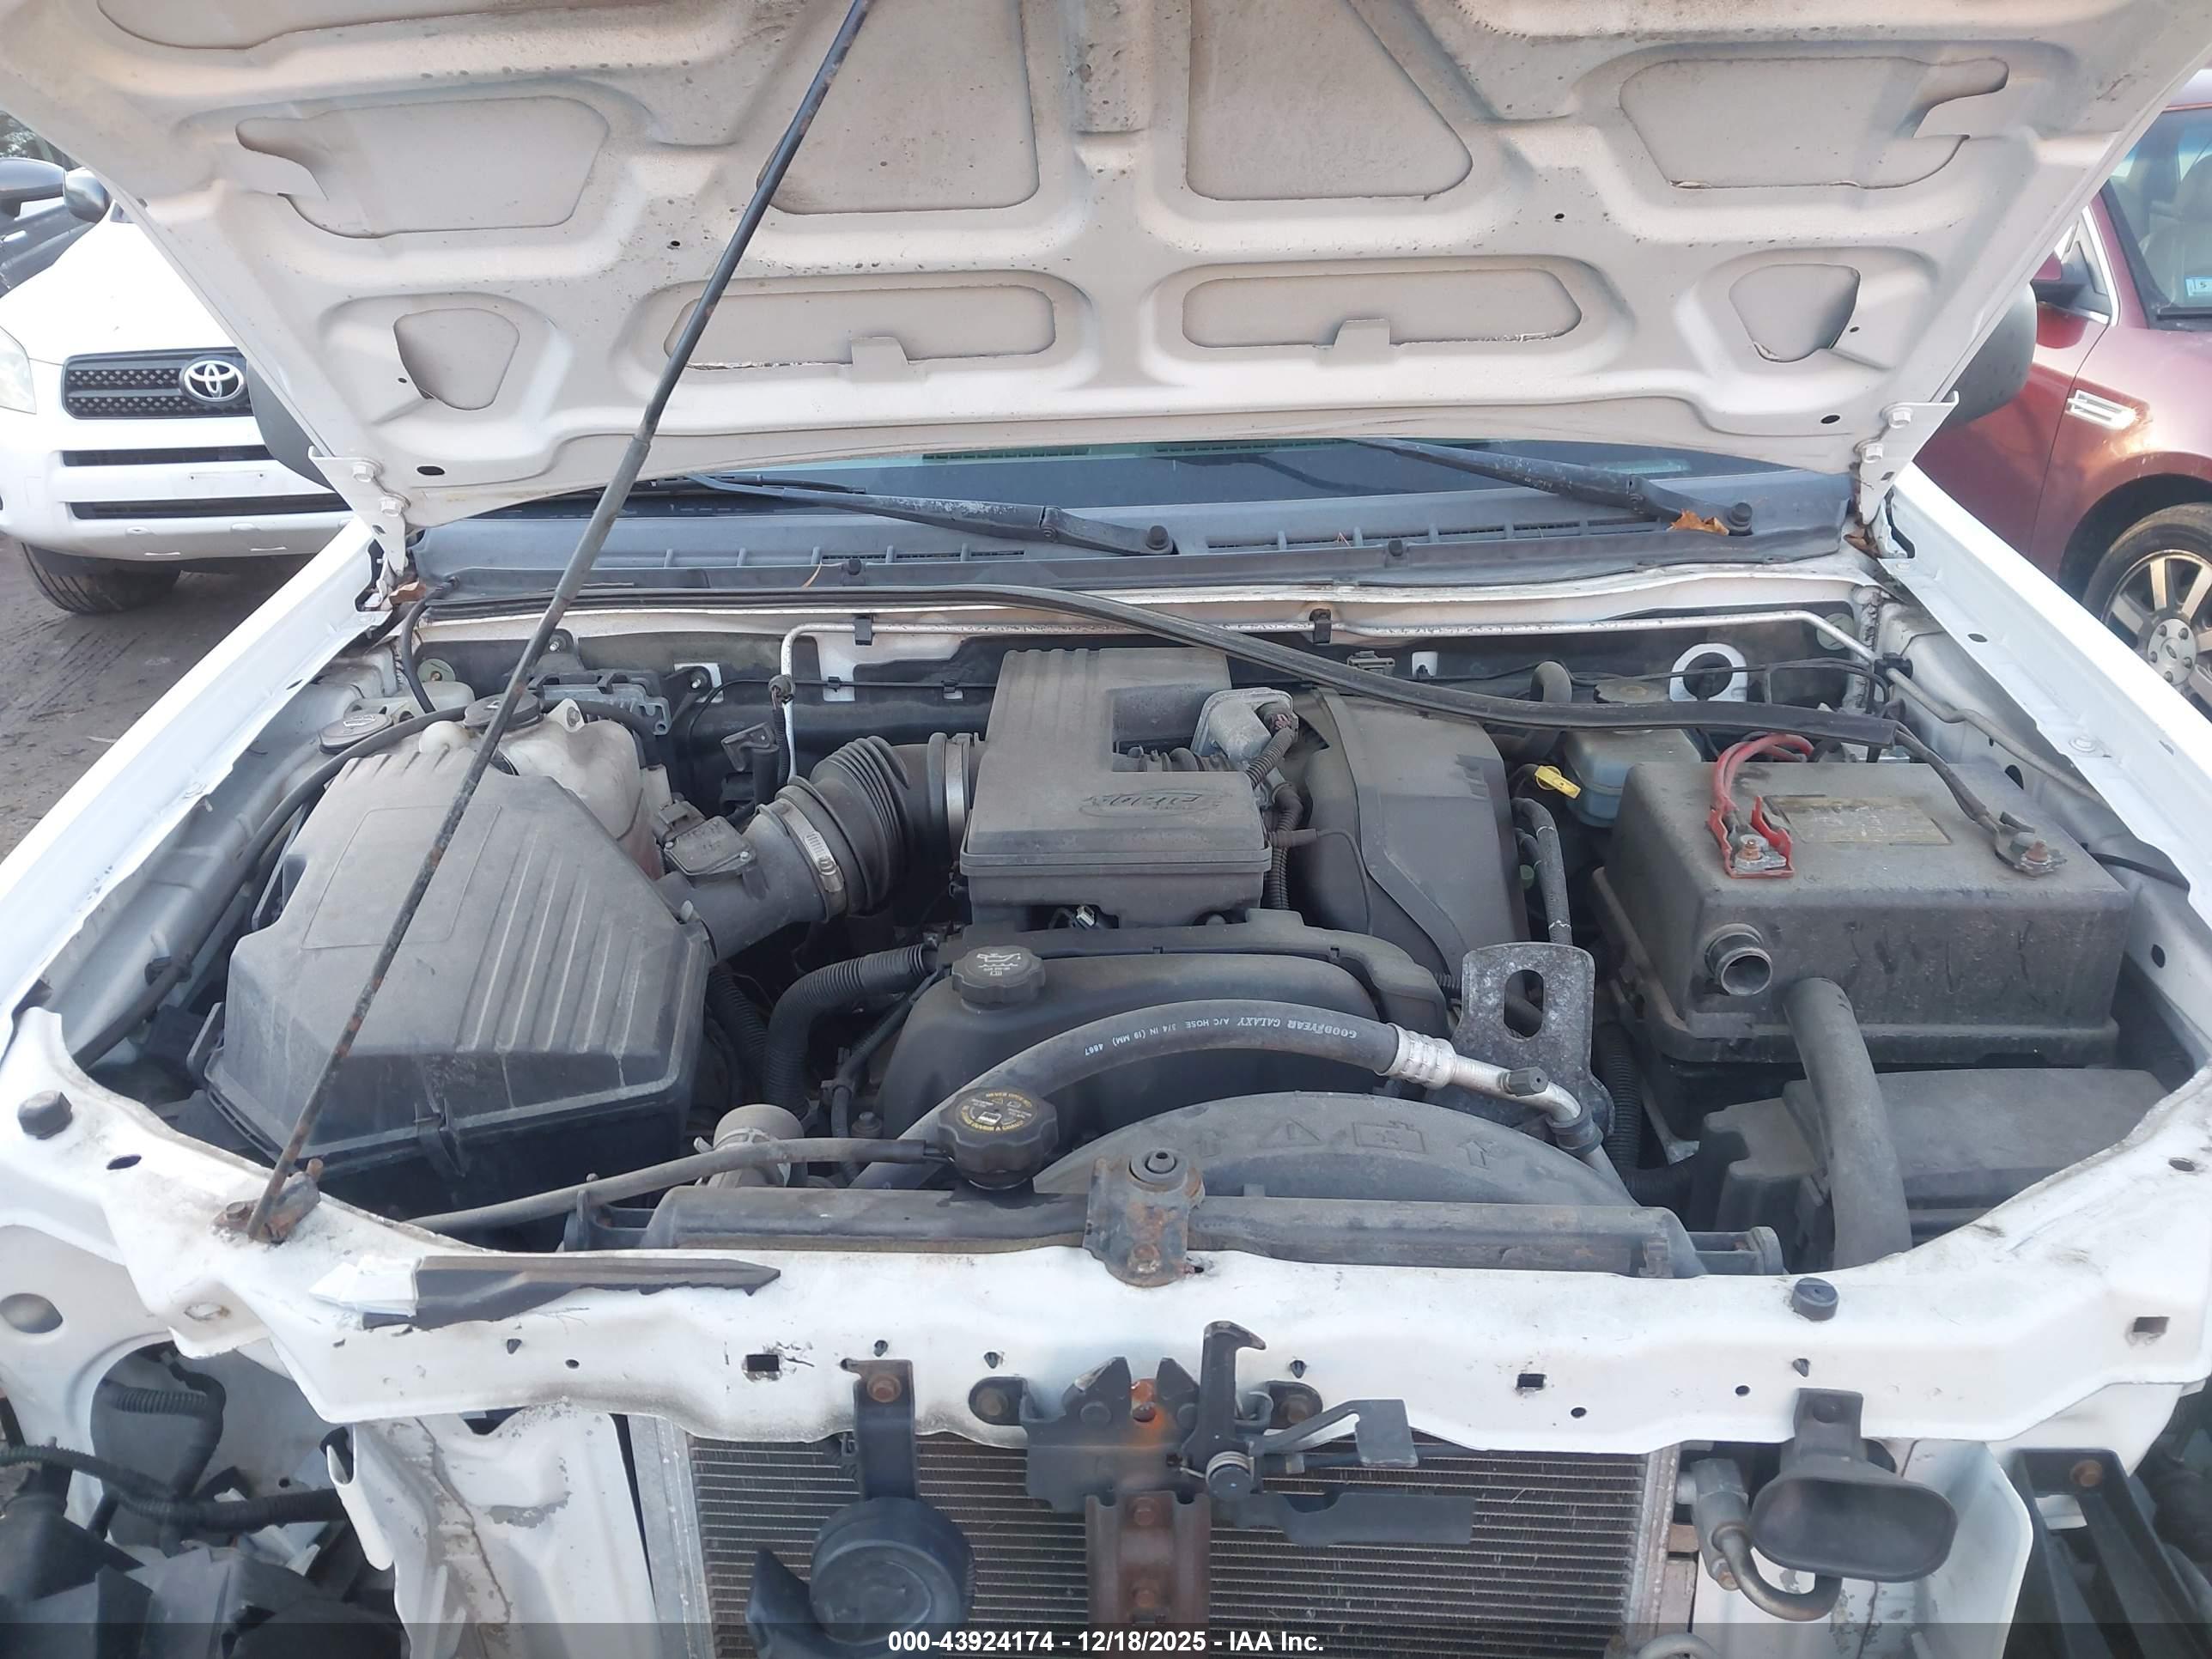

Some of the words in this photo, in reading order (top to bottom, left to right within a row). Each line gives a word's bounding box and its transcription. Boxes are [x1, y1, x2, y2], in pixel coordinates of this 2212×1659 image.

[1185, 1019, 1209, 1029] HOSE
[1237, 1017, 1281, 1027] GALAXY
[1150, 1027, 1159, 1036] IN
[1163, 1024, 1176, 1033] 3/4
[1287, 1019, 1358, 1039] GOODYEAR
[1133, 1030, 1146, 1039] (19
[1112, 1034, 1130, 1047] MM)
